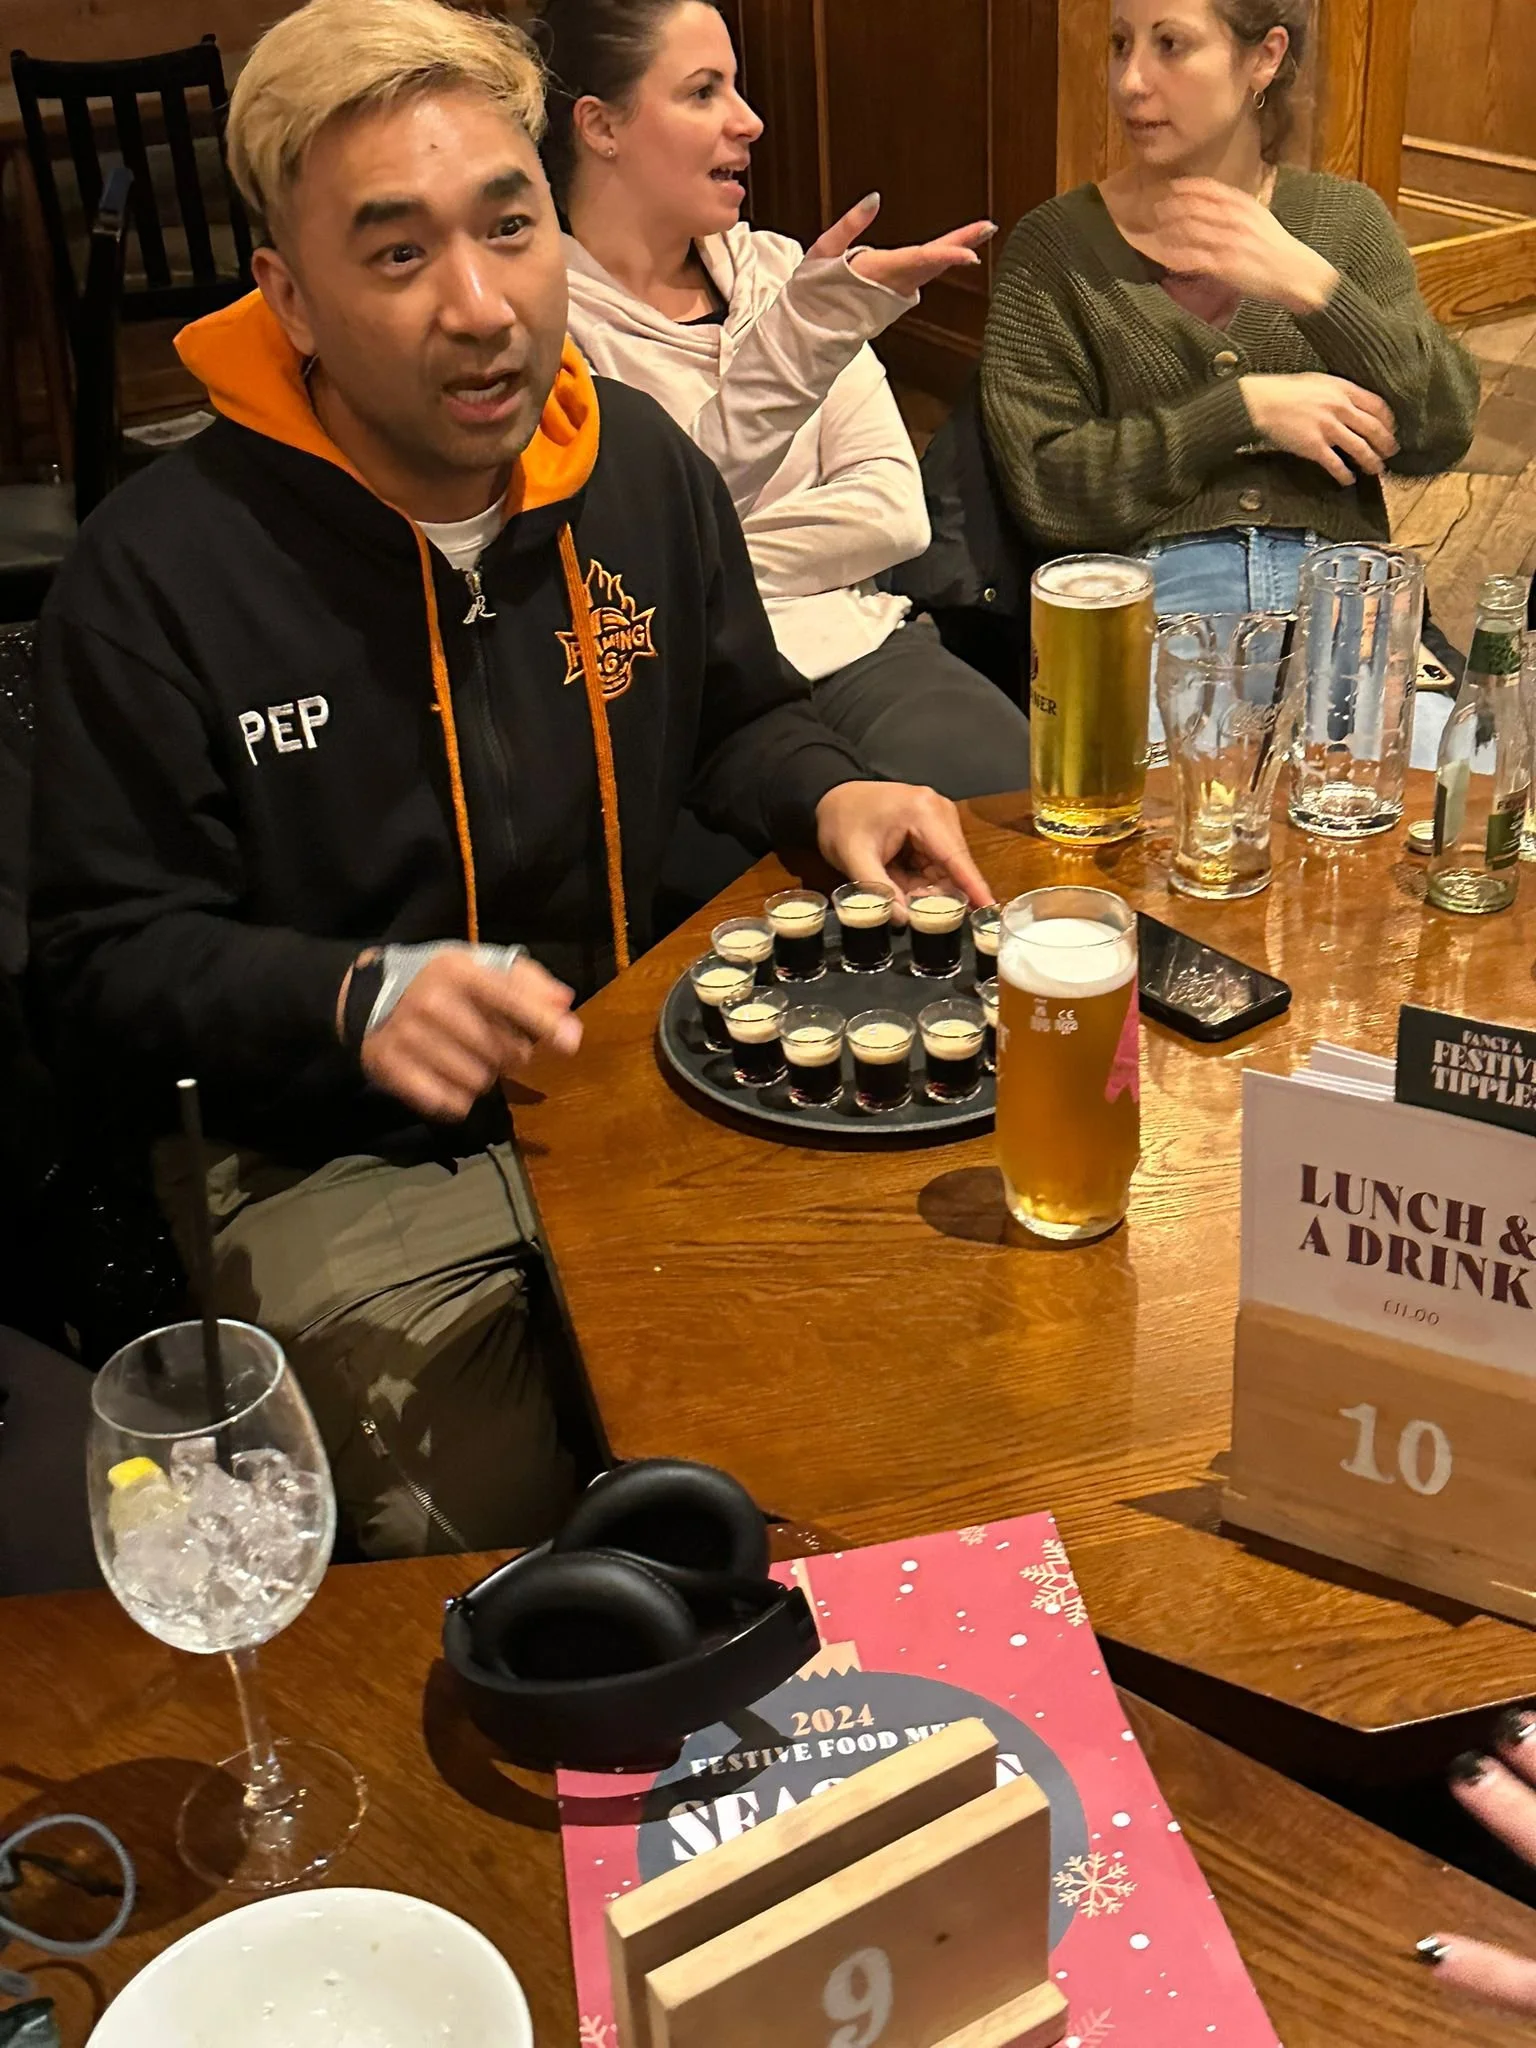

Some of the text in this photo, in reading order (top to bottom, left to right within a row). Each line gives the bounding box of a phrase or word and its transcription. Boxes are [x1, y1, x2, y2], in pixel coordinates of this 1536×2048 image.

[239, 695, 329, 766] PEP
[1462, 1030, 1523, 1054] FANCY A
[1300, 1163, 1536, 1262] LUNCH &
[1299, 1214, 1533, 1310] A DRINK
[1338, 1402, 1452, 1495] 10
[689, 1742, 814, 1777] FESTIVE
[817, 1730, 899, 1759] FOOD
[790, 1703, 876, 1736] 2024
[823, 1946, 894, 2048] 9
